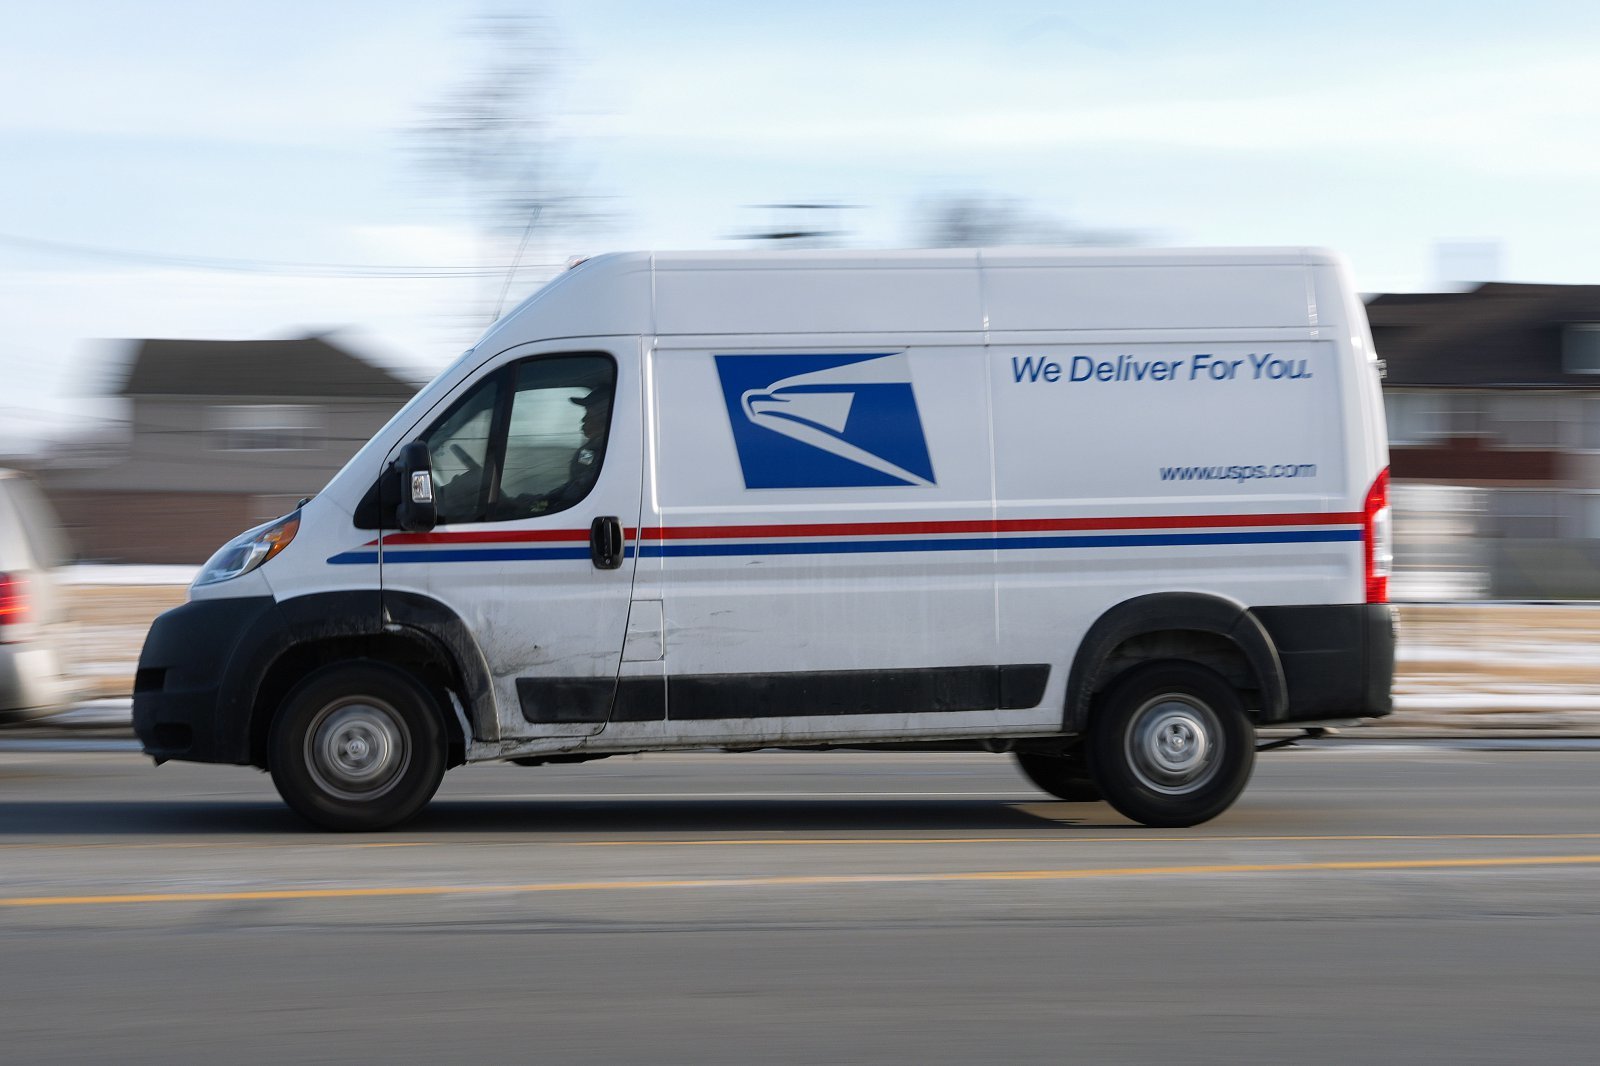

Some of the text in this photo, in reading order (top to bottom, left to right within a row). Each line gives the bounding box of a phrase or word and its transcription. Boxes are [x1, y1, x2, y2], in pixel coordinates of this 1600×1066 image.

[1012, 353, 1312, 383] We Deliver For You.
[1159, 463, 1316, 483] www.usps.com
